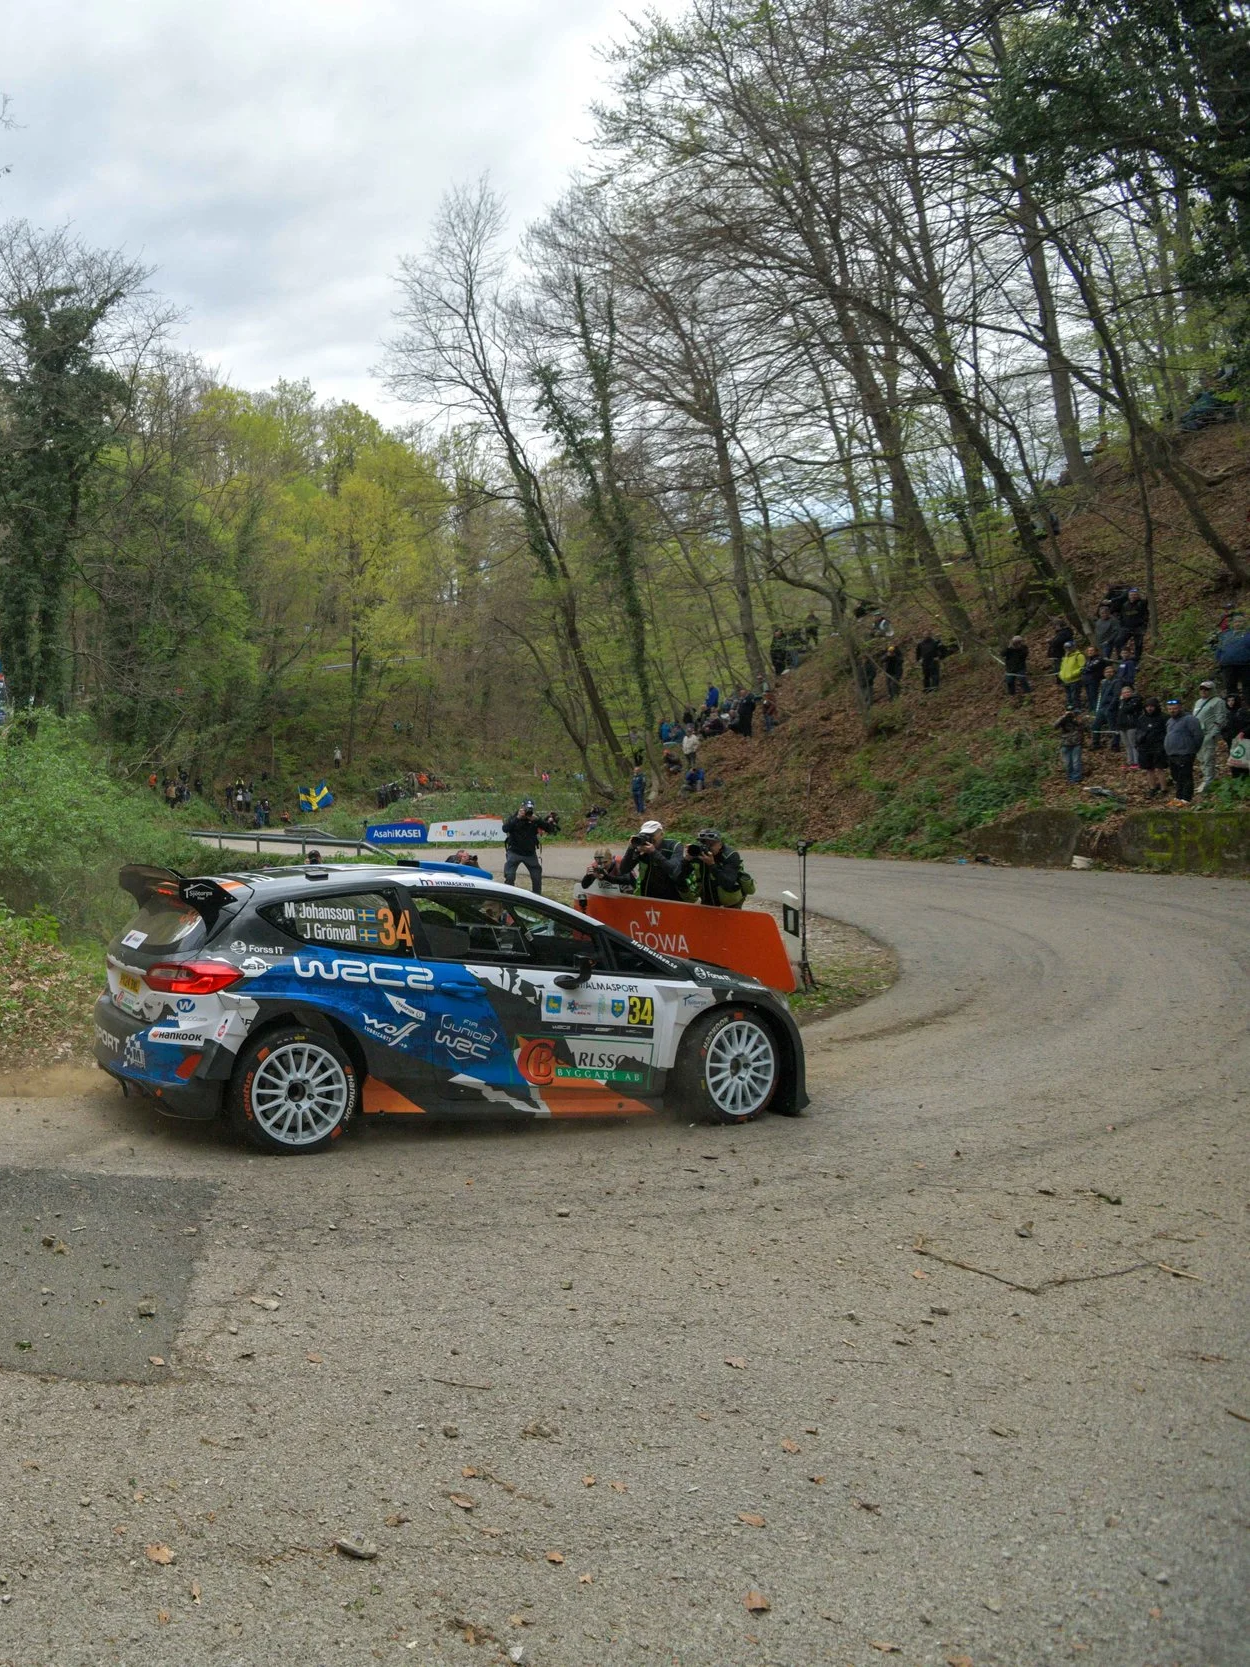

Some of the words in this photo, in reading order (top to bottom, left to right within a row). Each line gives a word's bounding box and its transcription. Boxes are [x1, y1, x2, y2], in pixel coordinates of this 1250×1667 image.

[373, 829, 421, 838] AsahiKASEI
[284, 901, 296, 918] M
[299, 902, 356, 921] Johansson
[303, 923, 311, 939] J
[313, 924, 358, 941] Grönvall
[377, 908, 414, 947] 34
[249, 944, 274, 954] Forss
[275, 946, 285, 955] IT
[293, 956, 435, 991] WRC2
[628, 996, 654, 1025] 34
[463, 1018, 479, 1028] FIA
[443, 1023, 492, 1044] JUNIOR
[434, 1030, 491, 1060] WRC
[557, 1068, 617, 1081] BYGGARE
[625, 1073, 641, 1082] AB
